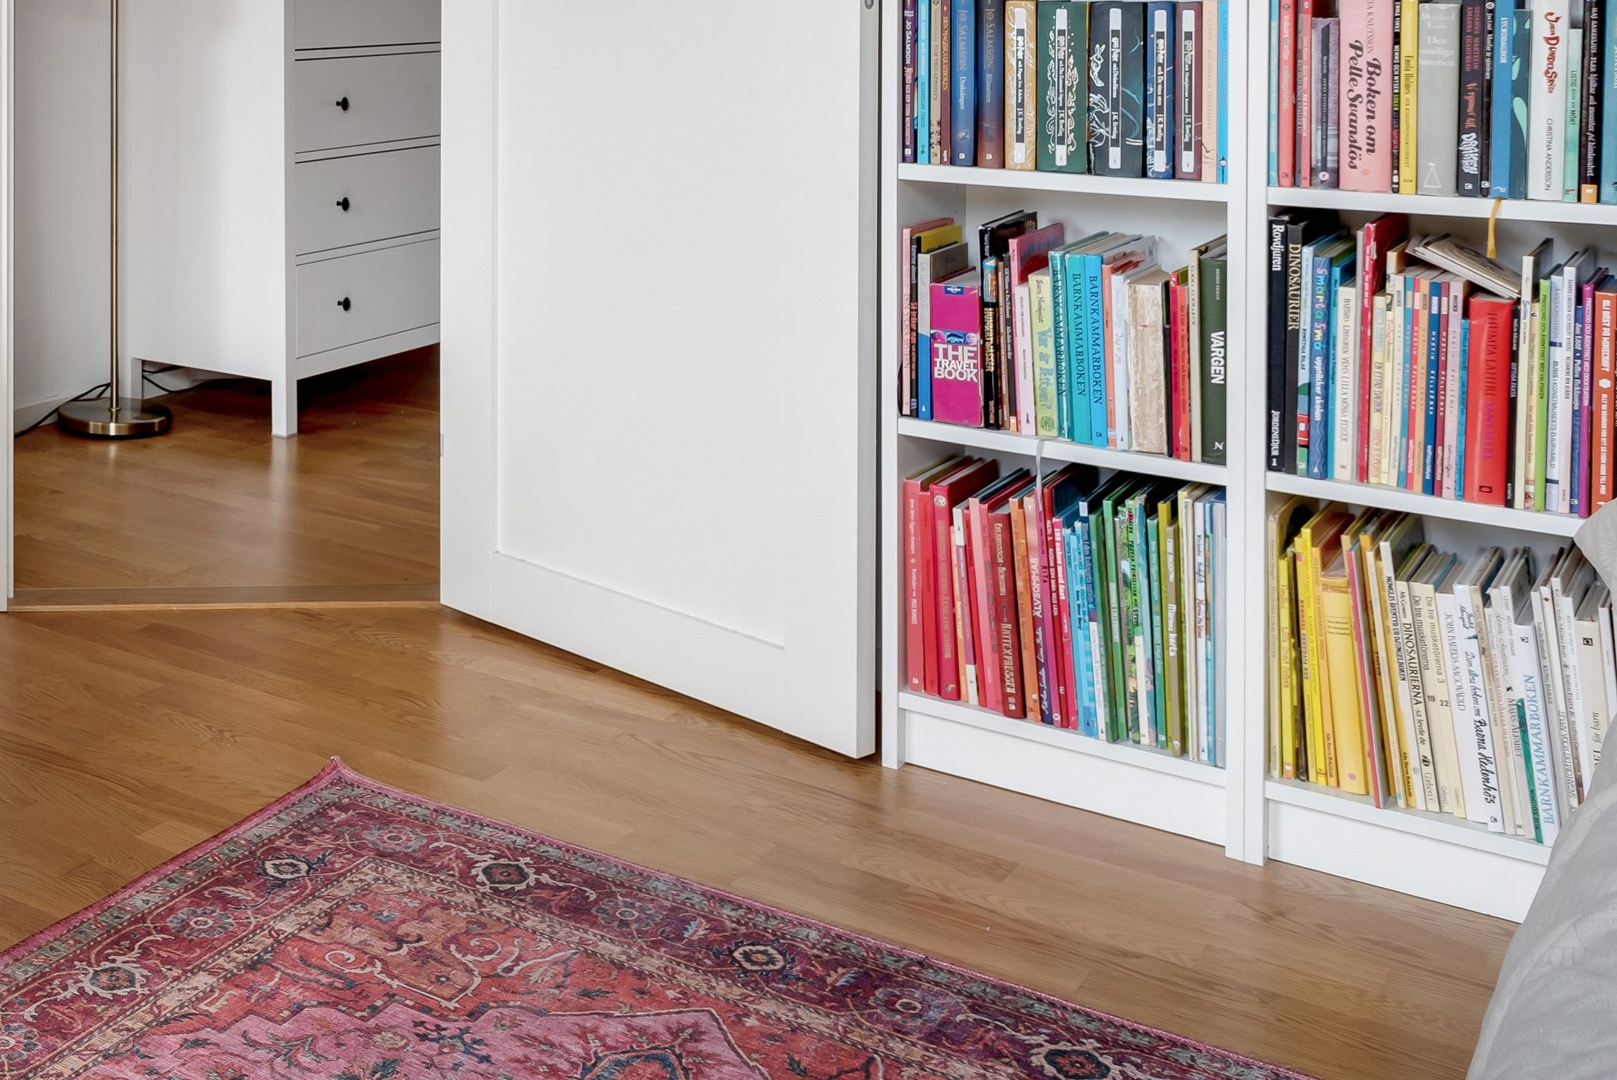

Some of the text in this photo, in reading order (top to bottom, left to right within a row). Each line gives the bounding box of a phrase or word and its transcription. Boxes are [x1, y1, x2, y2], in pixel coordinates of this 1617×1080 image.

[905, 20, 912, 30] JO
[958, 9, 968, 71] JO SALMSON
[985, 8, 996, 68] JO SALMSON
[1366, 12, 1375, 54] KNUTSSON
[1499, 17, 1508, 64] LYCKODAGBOK
[958, 76, 967, 110] Draksången
[985, 73, 994, 103] Blånatten
[1403, 55, 1414, 95] Enola Holmes
[1346, 40, 1364, 169] Pelle Svanslös
[1366, 58, 1382, 155] Boken om
[1459, 132, 1479, 175] DRAKEN
[1544, 118, 1554, 191] CHRISTINA ANDERSSON
[1271, 224, 1285, 271] Rovdjuren
[1035, 279, 1045, 295] Sven
[1287, 243, 1301, 331] DINOSAURIER
[1342, 298, 1352, 322] BARBRO
[933, 343, 978, 364] THE
[983, 307, 995, 372] HUNDERTWASSER
[1053, 268, 1068, 397] BARNKAMMARBOKEN
[1071, 273, 1087, 397] BARNKAMMARBOKEN
[1087, 275, 1103, 405] BARNKAMMARBOKEN
[1313, 268, 1328, 421] Smarta Små upptäcker skolan
[1341, 324, 1351, 355] LINDGREN
[933, 359, 977, 370] TRAVEL
[933, 367, 978, 383] BOOK
[1210, 331, 1225, 384] VARGEN
[1341, 356, 1351, 375] VEMS
[1484, 312, 1499, 397] JHUMPA LAHIRI
[1340, 376, 1351, 396] LILLA
[1340, 397, 1351, 418] MÖSSA
[1549, 381, 1559, 469] KONSTMUSEETS DJURVÄRLD
[1040, 565, 1049, 584] RITA
[1054, 528, 1066, 601] 199 saker med fart
[1030, 557, 1043, 618] ÄLVSOMMAR
[1385, 576, 1396, 601] MOWGLIS
[1398, 591, 1408, 619] McGowen
[1387, 601, 1399, 627] ÄVENTYR
[1412, 595, 1431, 671] De tre musketörerna
[1000, 622, 1016, 694] HATTEXPRESSEN
[1392, 636, 1406, 682] DJUNGELBOKEN
[1424, 596, 1445, 684] De tre musketörerna 3
[1463, 651, 1477, 668] Den
[1402, 622, 1423, 706] DINOSAURIERNA
[1541, 664, 1553, 705] KUNG BABAR
[1427, 694, 1435, 702] 19
[1440, 699, 1450, 707] 22
[1467, 685, 1481, 706] boken
[1415, 719, 1425, 736] levde
[1418, 736, 1427, 746] de
[1473, 719, 1488, 752] Barna
[1506, 698, 1523, 758] MAJAS ALFABET
[1523, 674, 1556, 825] BARNKAMMARBOKEN
[1477, 753, 1497, 805] Hedenhös
